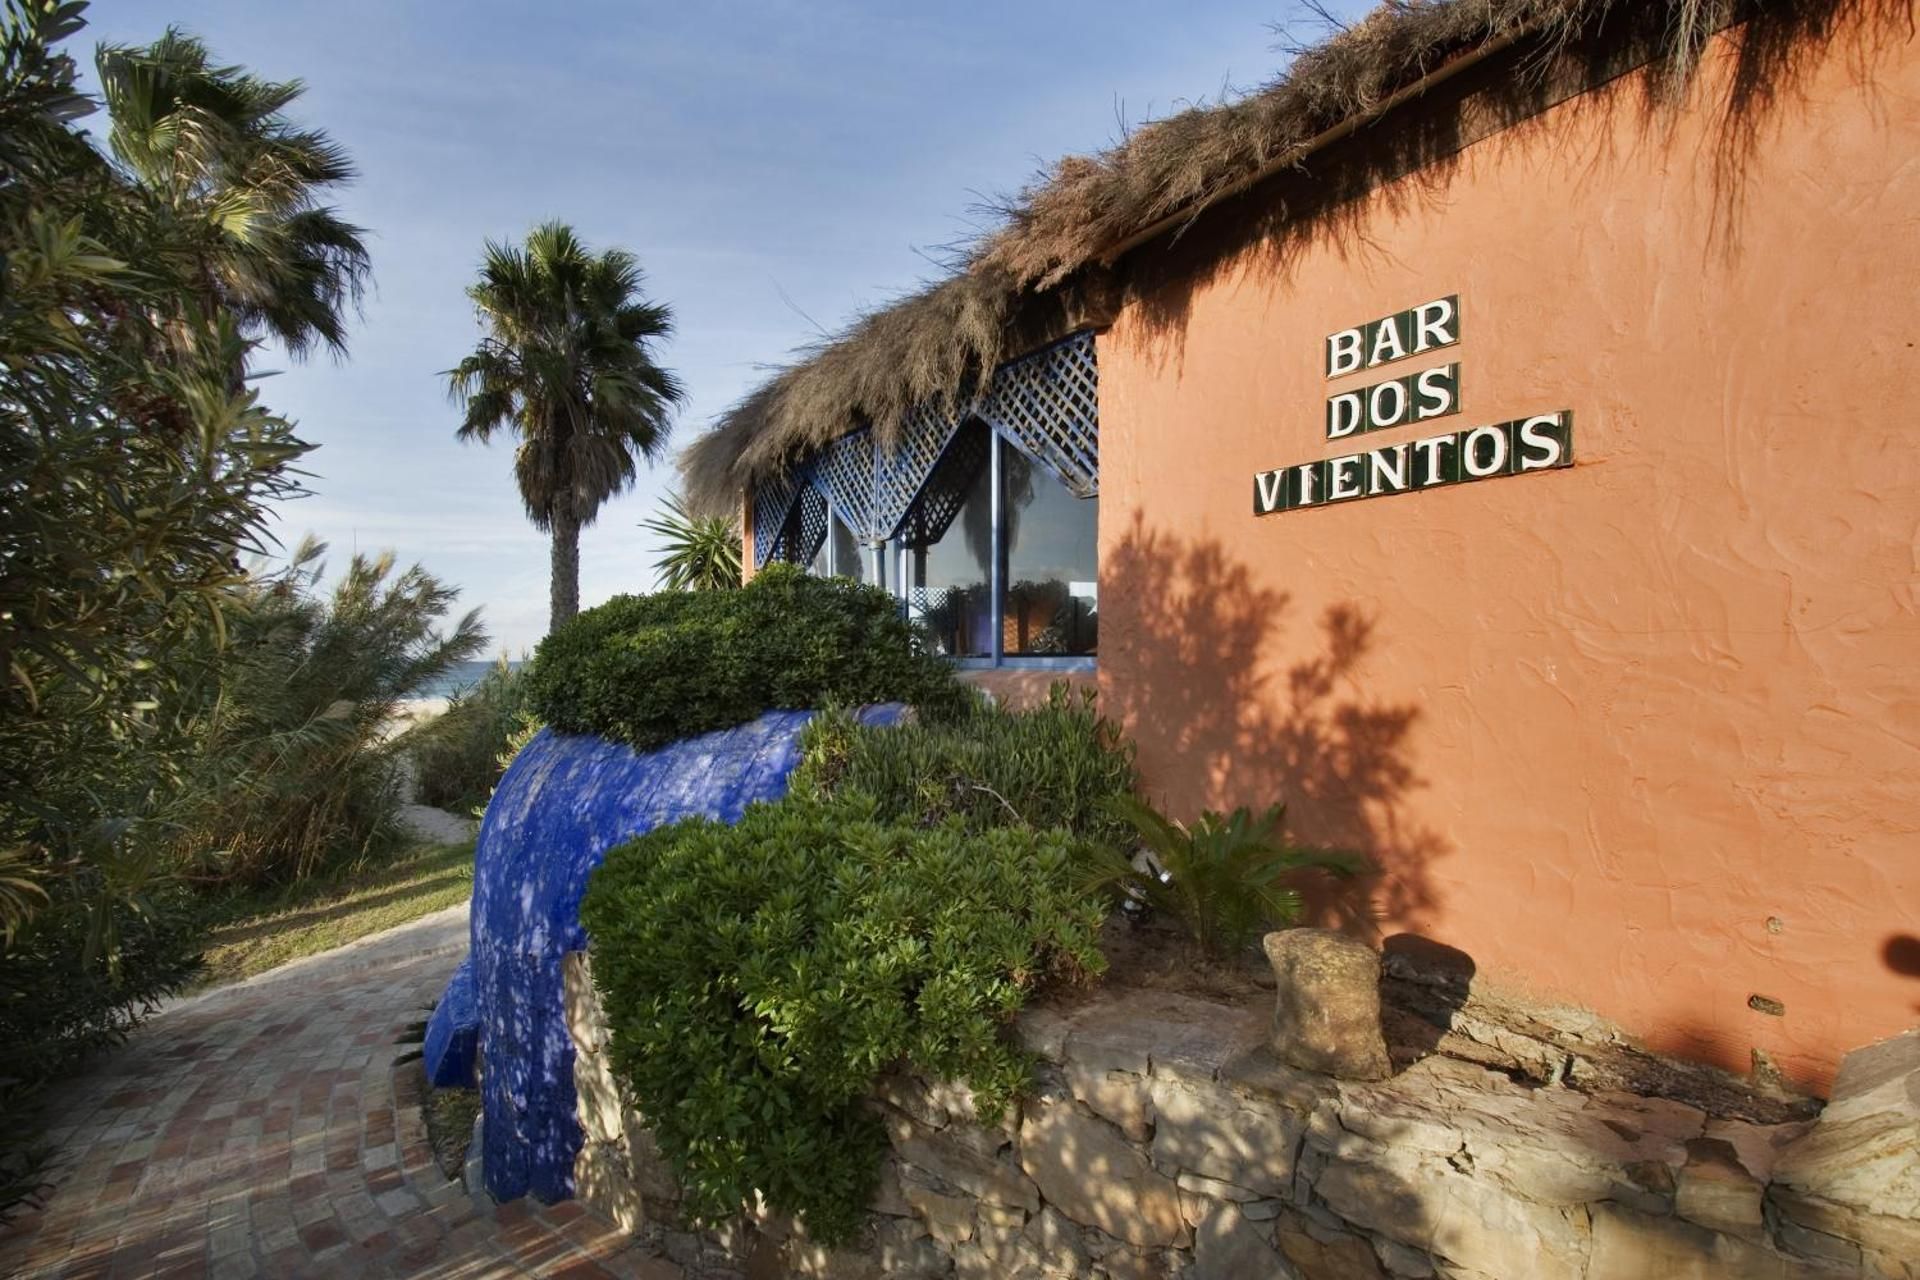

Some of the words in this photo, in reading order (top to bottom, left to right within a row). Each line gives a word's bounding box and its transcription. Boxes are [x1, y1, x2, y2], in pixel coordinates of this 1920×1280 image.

[1327, 299, 1456, 378] BAR
[1327, 365, 1453, 439] DOS
[1255, 413, 1562, 512] VIENTOS
